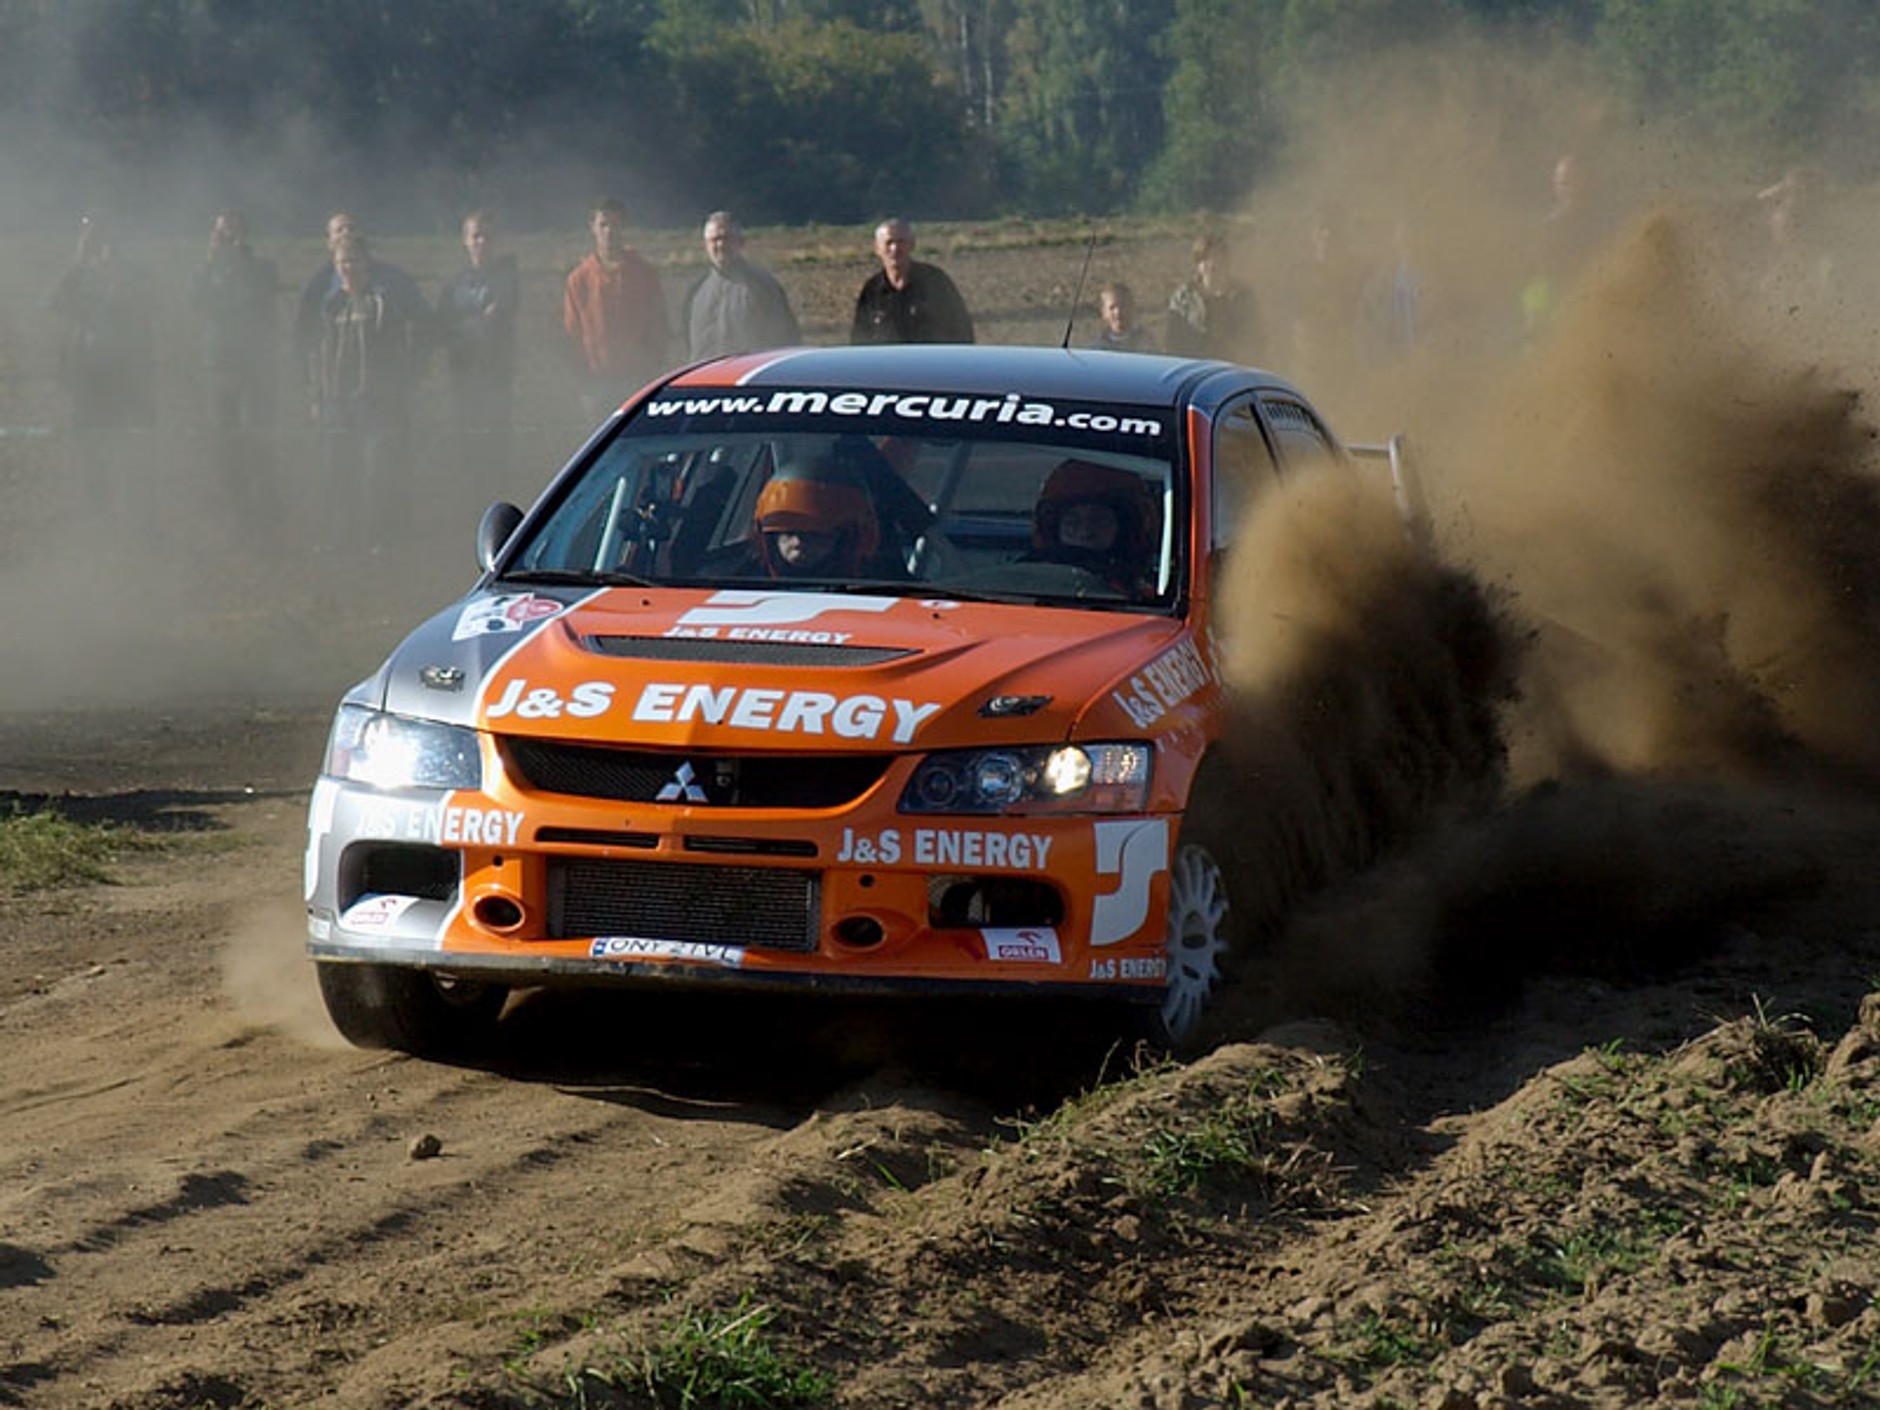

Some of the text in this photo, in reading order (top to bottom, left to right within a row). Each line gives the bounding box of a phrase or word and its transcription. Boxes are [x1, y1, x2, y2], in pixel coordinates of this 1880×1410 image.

[646, 391, 1162, 435] www.mercuria.com
[727, 627, 854, 645] ENERGY
[486, 679, 941, 744] J&S ENERGY
[405, 807, 526, 846] ENERGY
[836, 827, 1053, 869] J&S ENERGY
